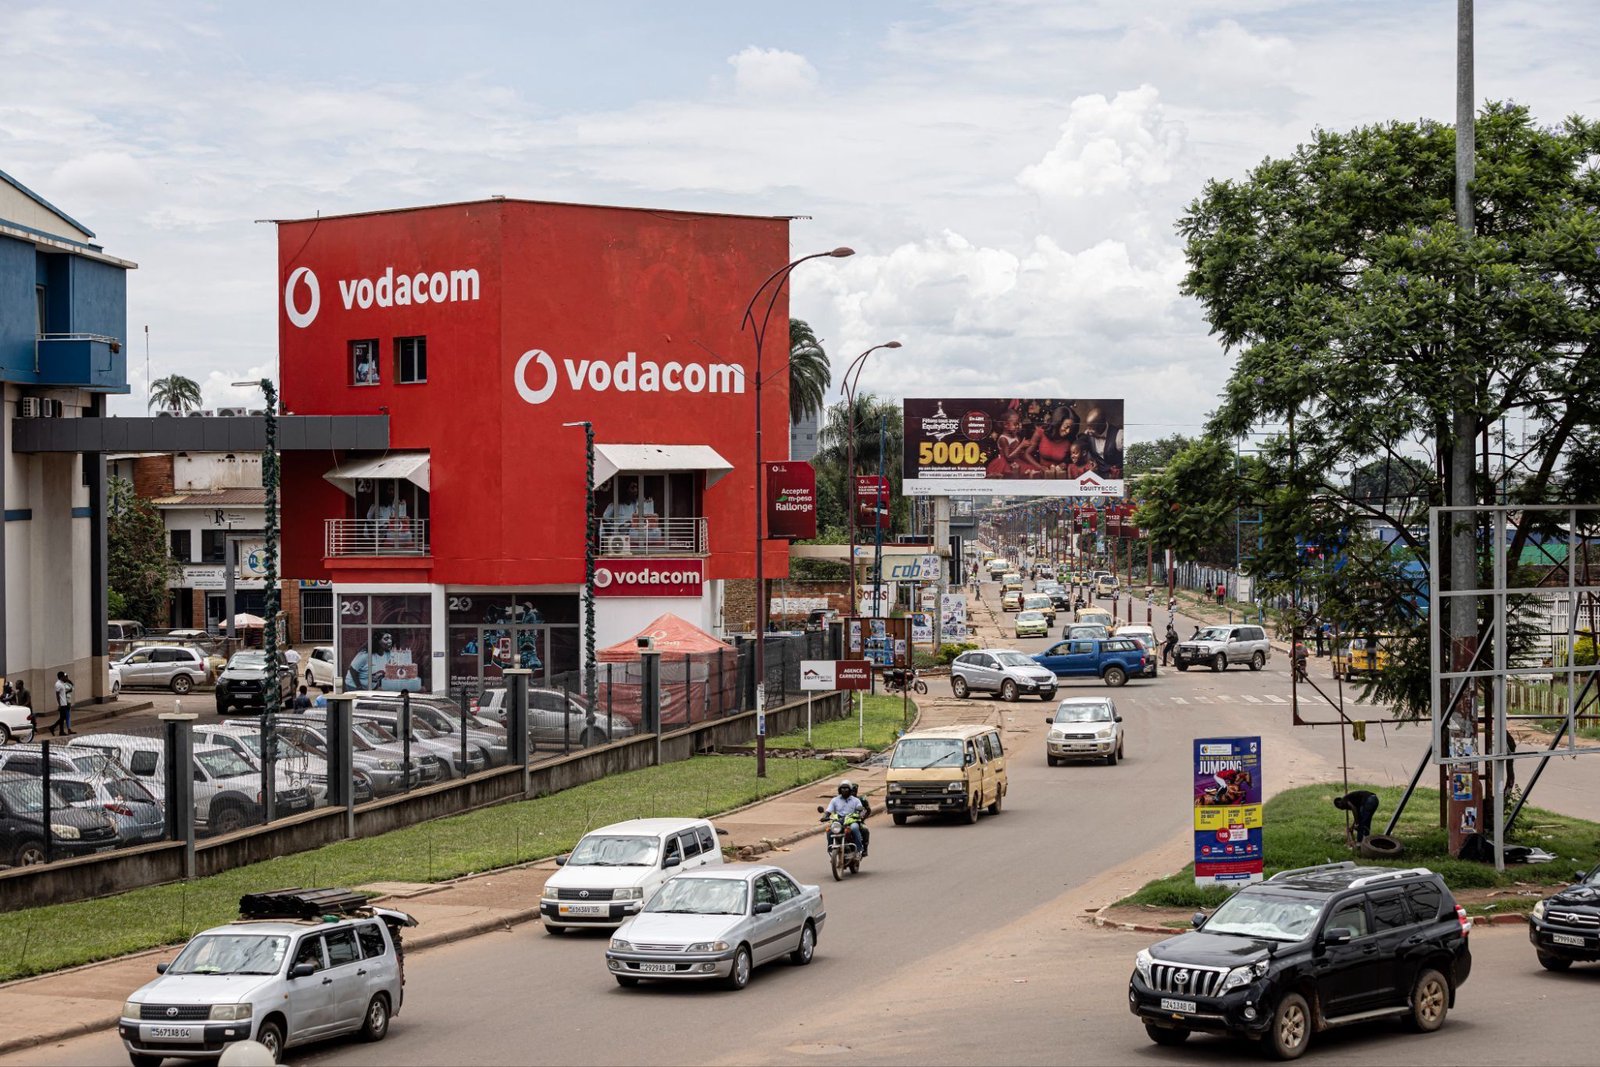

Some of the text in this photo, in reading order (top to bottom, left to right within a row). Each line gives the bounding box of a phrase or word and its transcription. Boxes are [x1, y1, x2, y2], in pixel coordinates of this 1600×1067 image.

[339, 267, 480, 310] vodacom
[563, 352, 745, 394] vodacom
[919, 442, 988, 465] 5000$
[775, 502, 813, 513] Rallonge
[614, 568, 700, 585] vodacom
[1198, 760, 1242, 775] JUMPING
